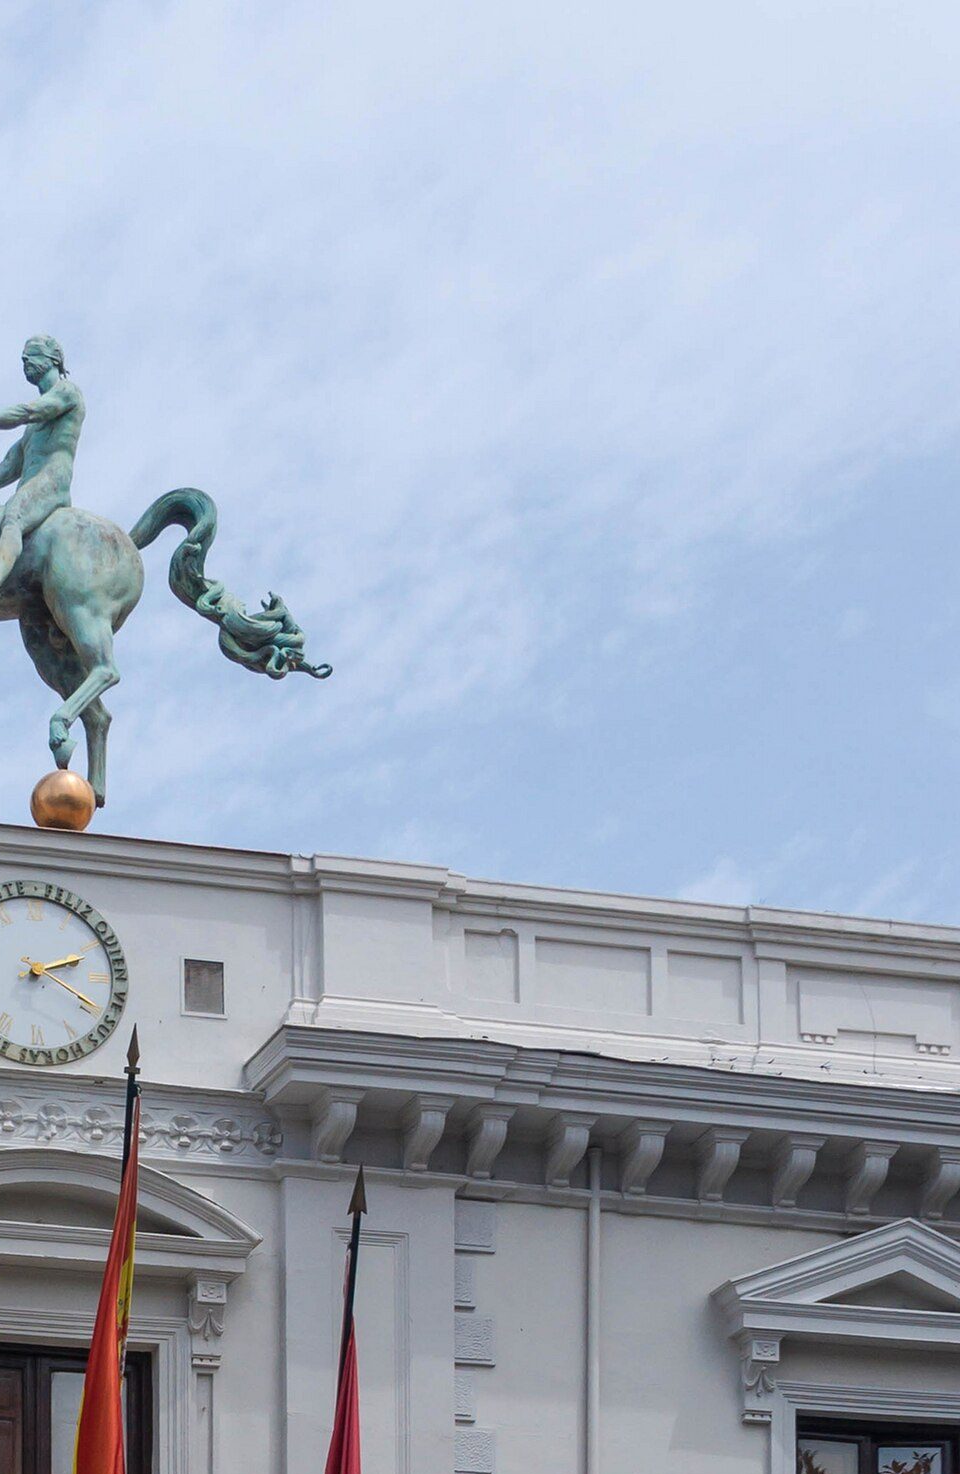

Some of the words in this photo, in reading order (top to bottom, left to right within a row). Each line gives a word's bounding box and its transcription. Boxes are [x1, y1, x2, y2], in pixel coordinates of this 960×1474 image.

[44, 884, 93, 919] FELIZ
[80, 939, 99, 952] II
[88, 972, 110, 984] III
[110, 992, 127, 1012] VE
[91, 1014, 116, 1047] SUS
[19, 1043, 85, 1063] HORAS
